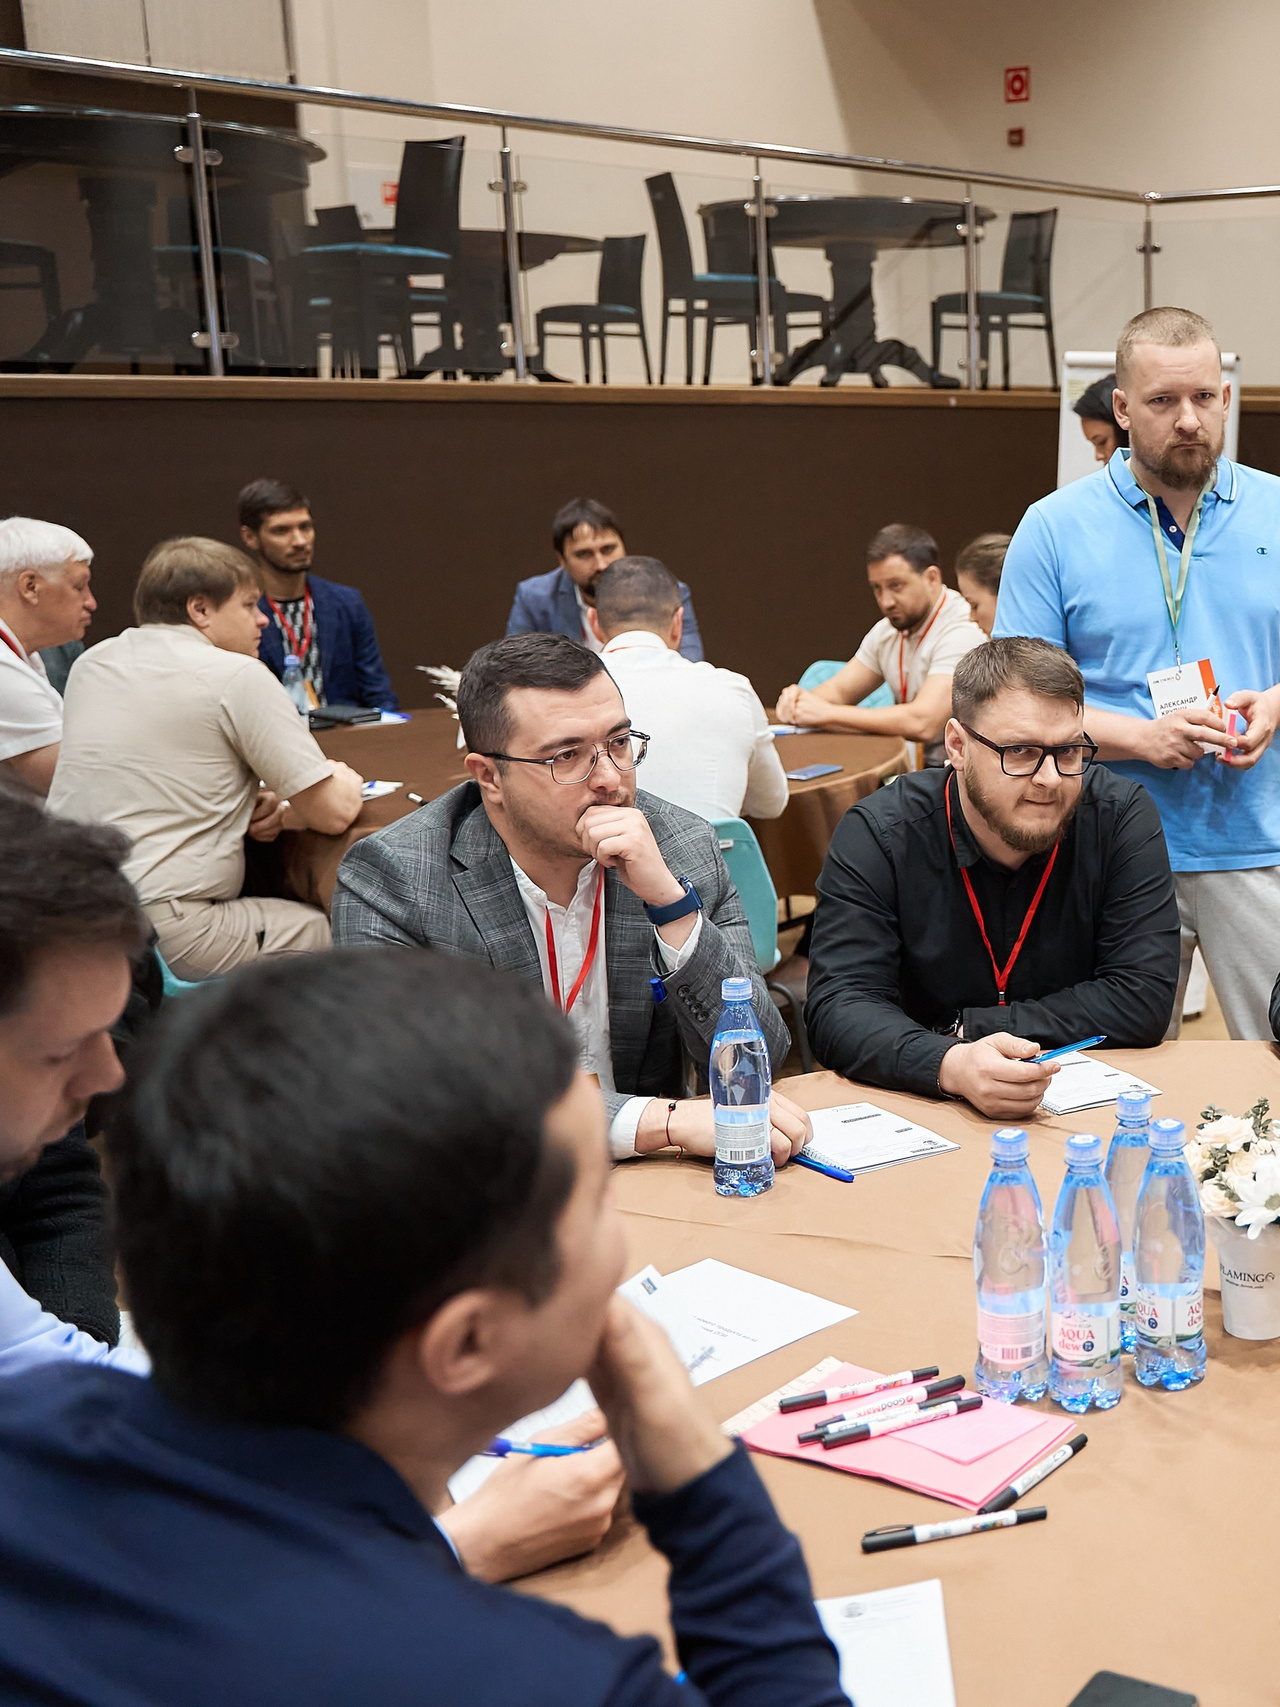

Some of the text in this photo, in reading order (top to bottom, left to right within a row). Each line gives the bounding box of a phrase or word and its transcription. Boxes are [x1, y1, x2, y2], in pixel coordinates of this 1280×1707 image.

[1159, 696, 1198, 710] АЛЕКСАНДР
[1137, 1302, 1159, 1318] QUA
[1058, 1327, 1095, 1342] AQUA
[1058, 1339, 1081, 1351] dew
